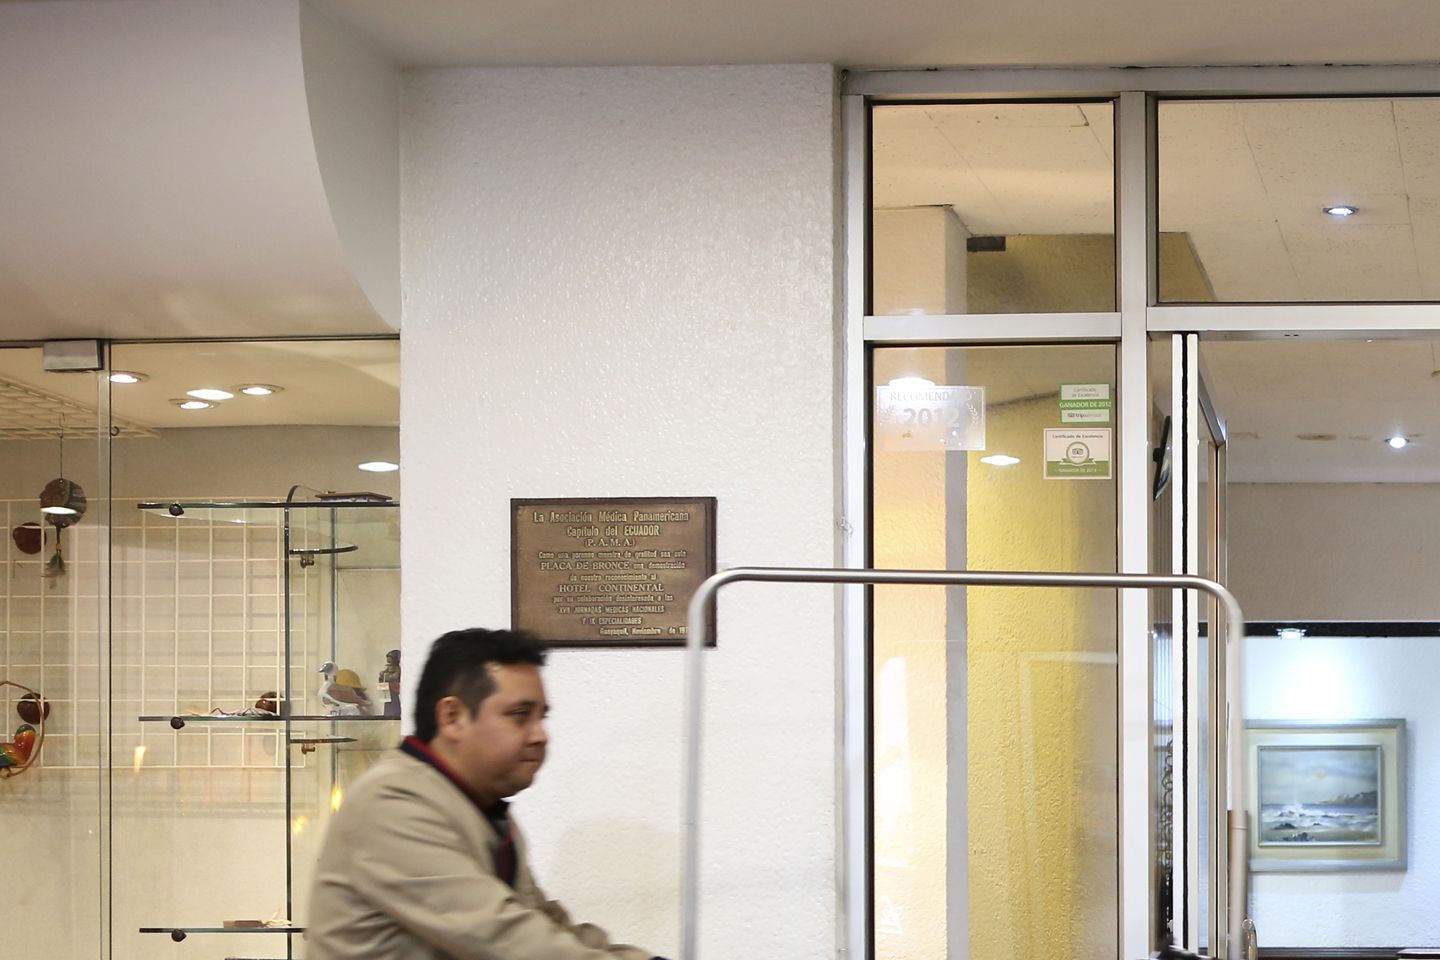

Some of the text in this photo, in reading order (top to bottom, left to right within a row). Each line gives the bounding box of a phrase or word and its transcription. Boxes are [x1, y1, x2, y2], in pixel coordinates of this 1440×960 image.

[534, 511, 545, 523] La
[633, 509, 689, 522] Panamericana
[605, 525, 619, 536] del
[624, 524, 660, 537] ECUADOR
[541, 561, 573, 571] PLACA
[576, 561, 589, 570] DE
[592, 561, 630, 570] BRONCE
[559, 583, 665, 593] HOTEL CONTINENTAL
